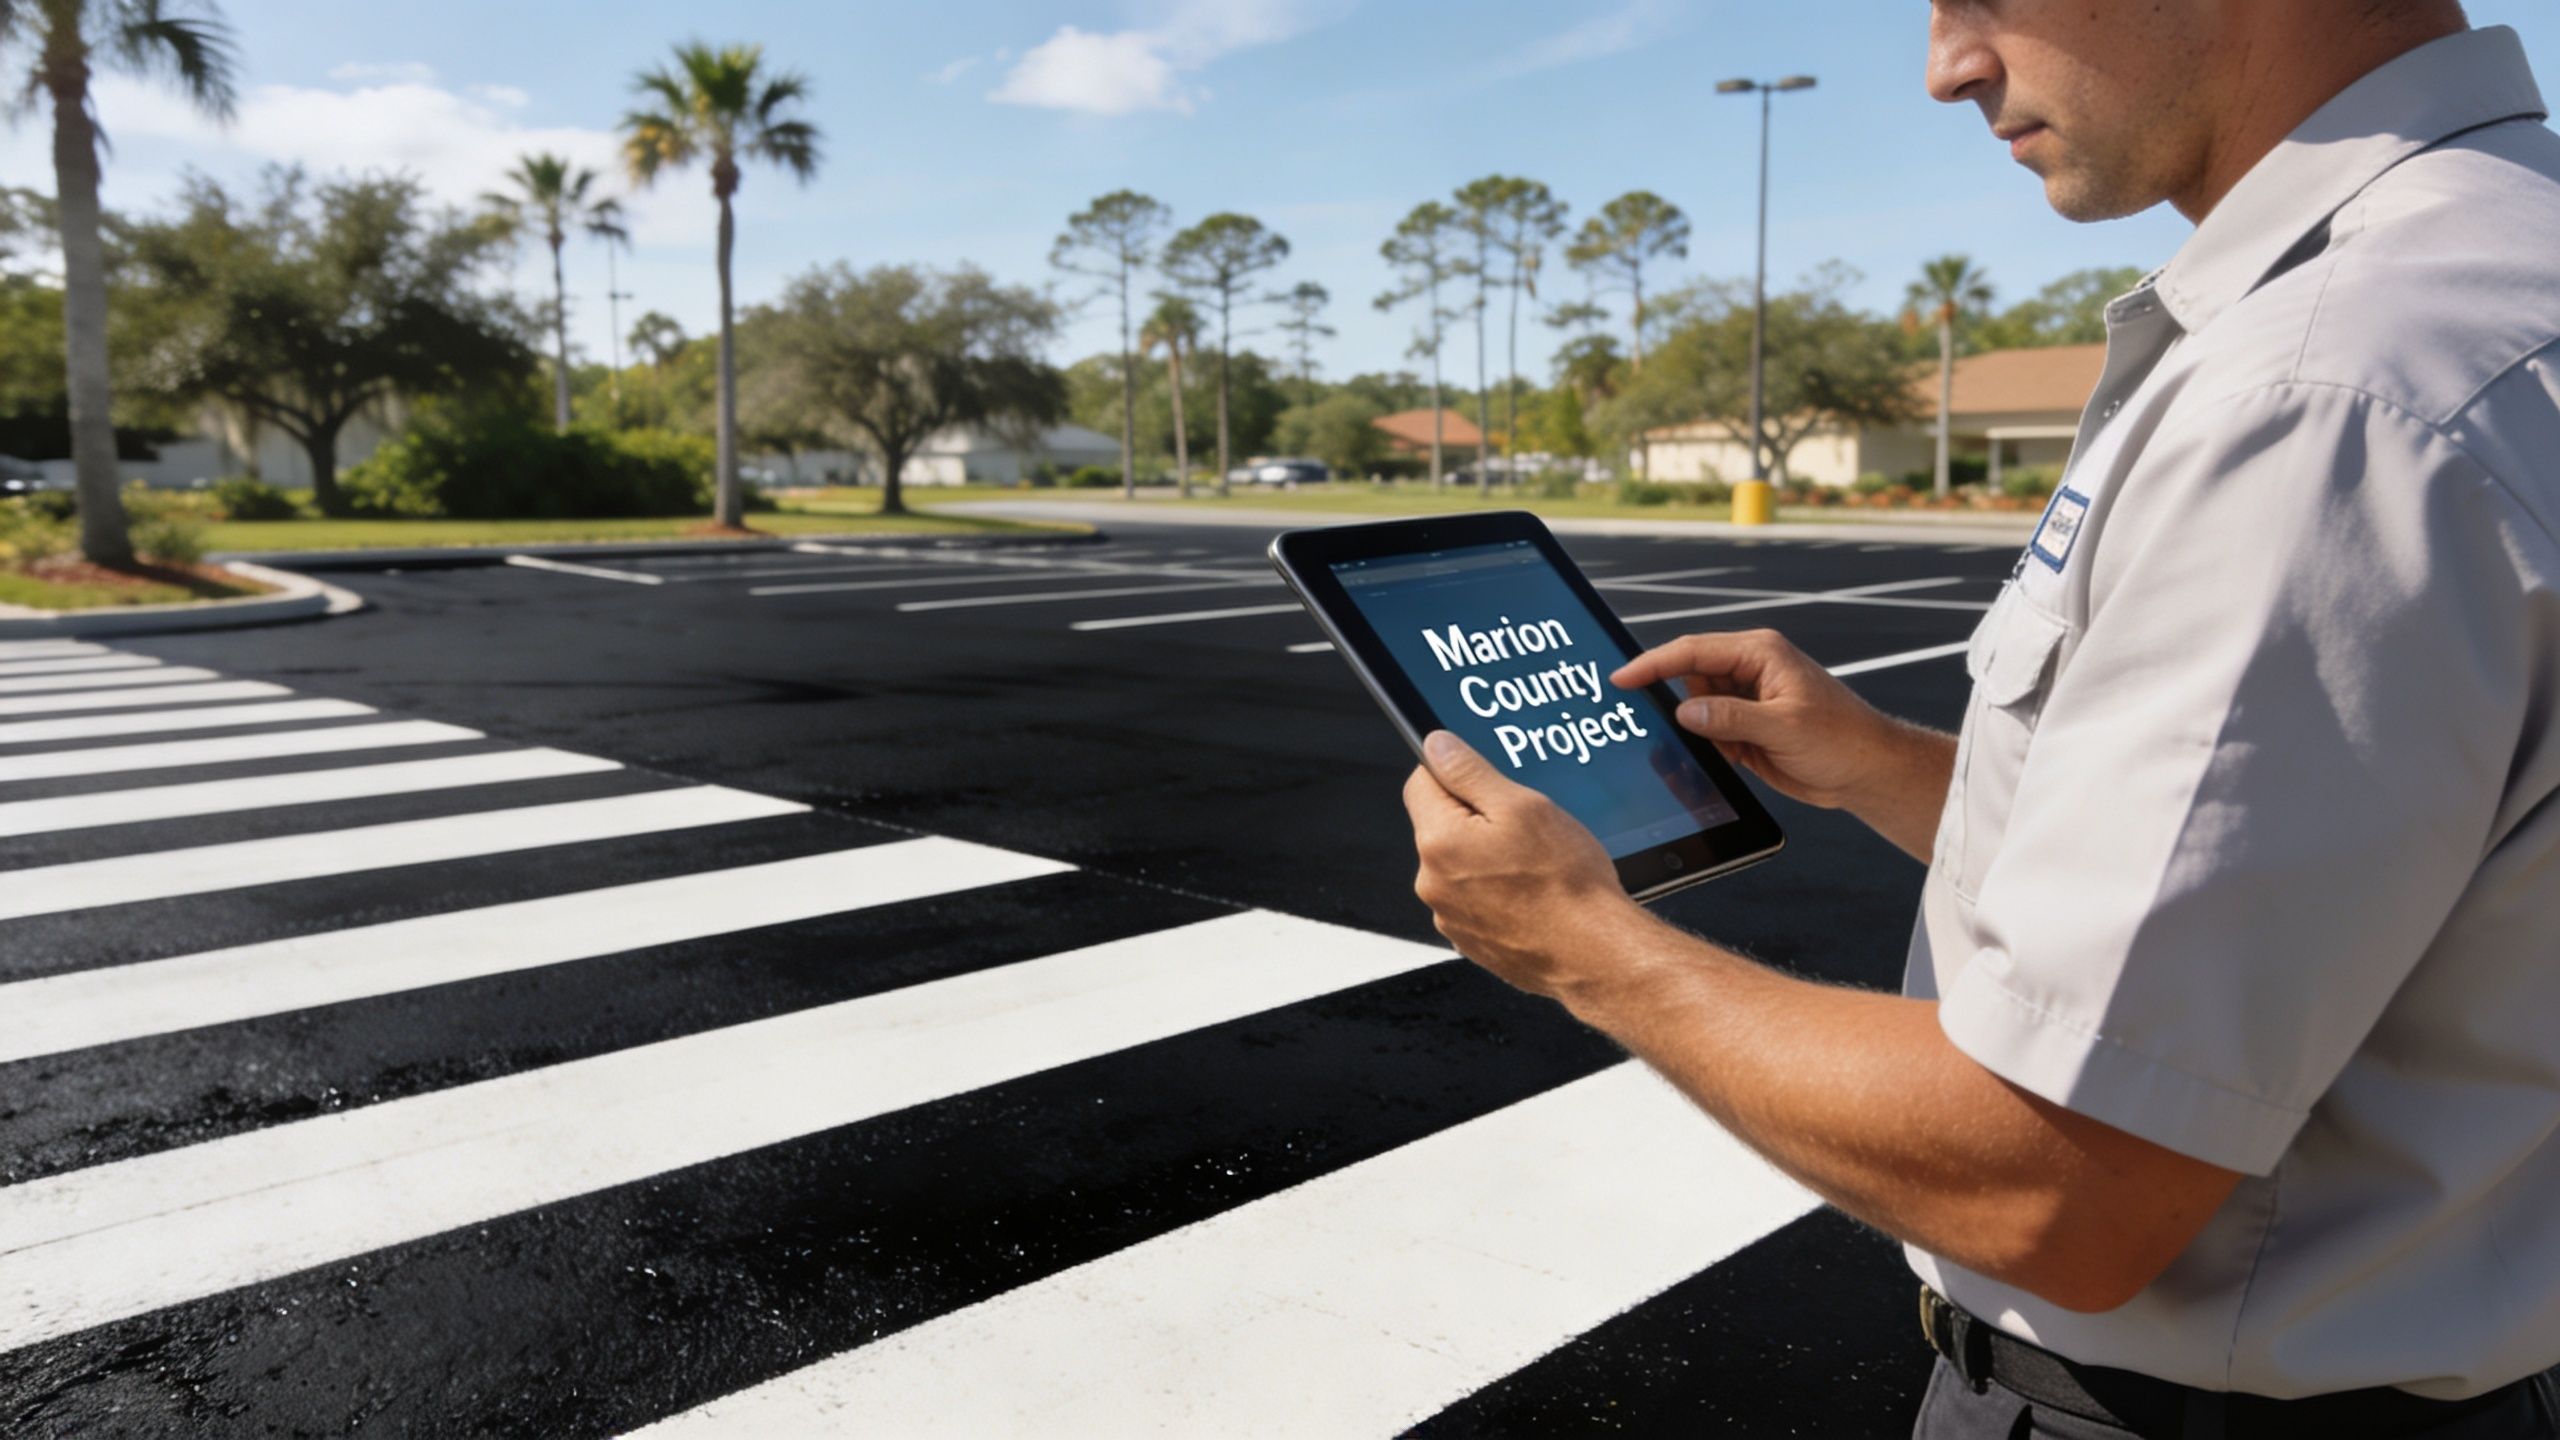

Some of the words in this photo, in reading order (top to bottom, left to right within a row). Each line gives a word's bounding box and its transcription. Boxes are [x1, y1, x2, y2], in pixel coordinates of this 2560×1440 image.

[1422, 616, 1573, 671] Marion
[1459, 660, 1602, 718] County
[1493, 701, 1648, 768] Project
